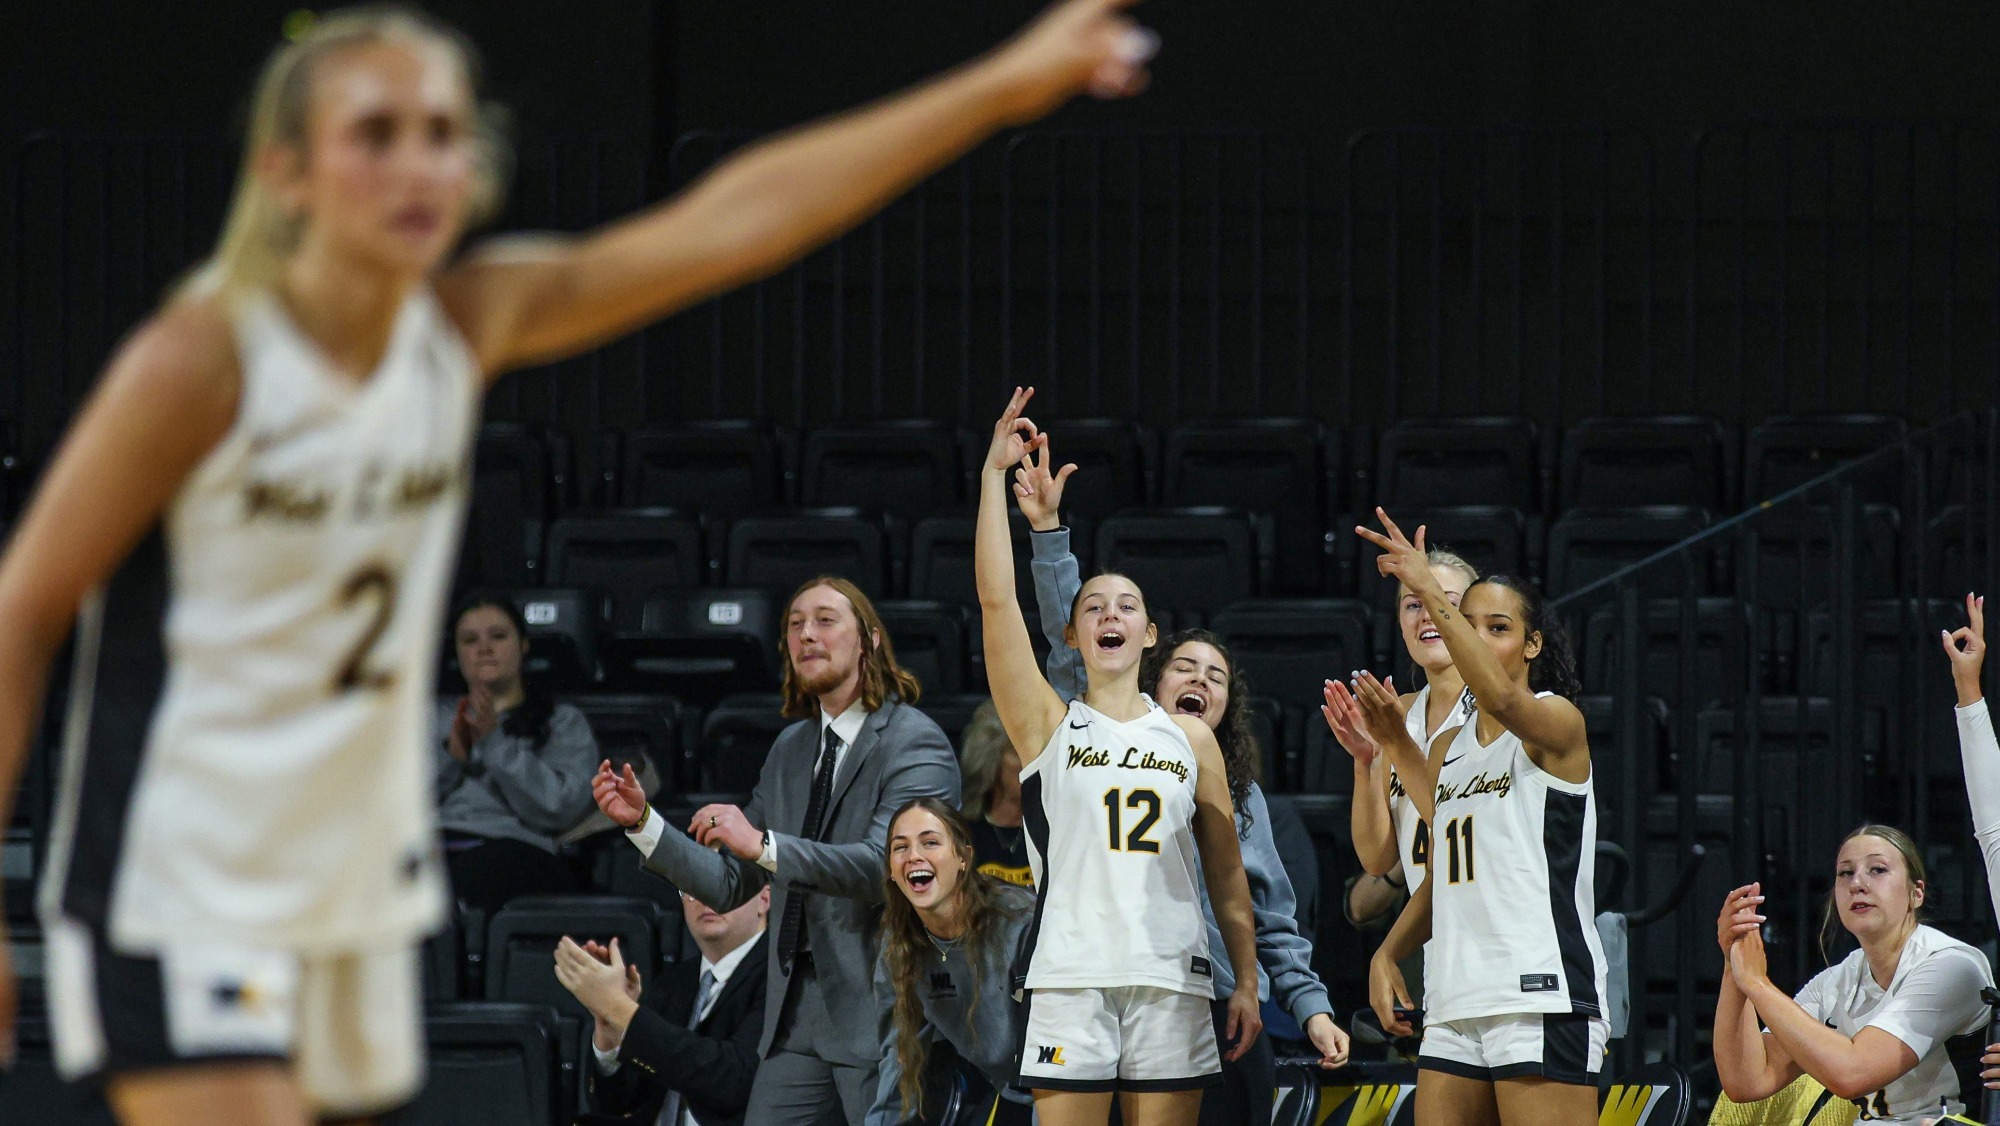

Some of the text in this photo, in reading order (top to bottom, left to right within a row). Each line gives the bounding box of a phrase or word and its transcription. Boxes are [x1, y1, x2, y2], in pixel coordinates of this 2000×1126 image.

[328, 556, 400, 696] 2
[1066, 744, 1188, 784] West Liberty
[1103, 787, 1162, 855] 12
[1411, 816, 1430, 870] 4
[1445, 814, 1475, 886] 11
[1035, 1045, 1066, 1066] WL
